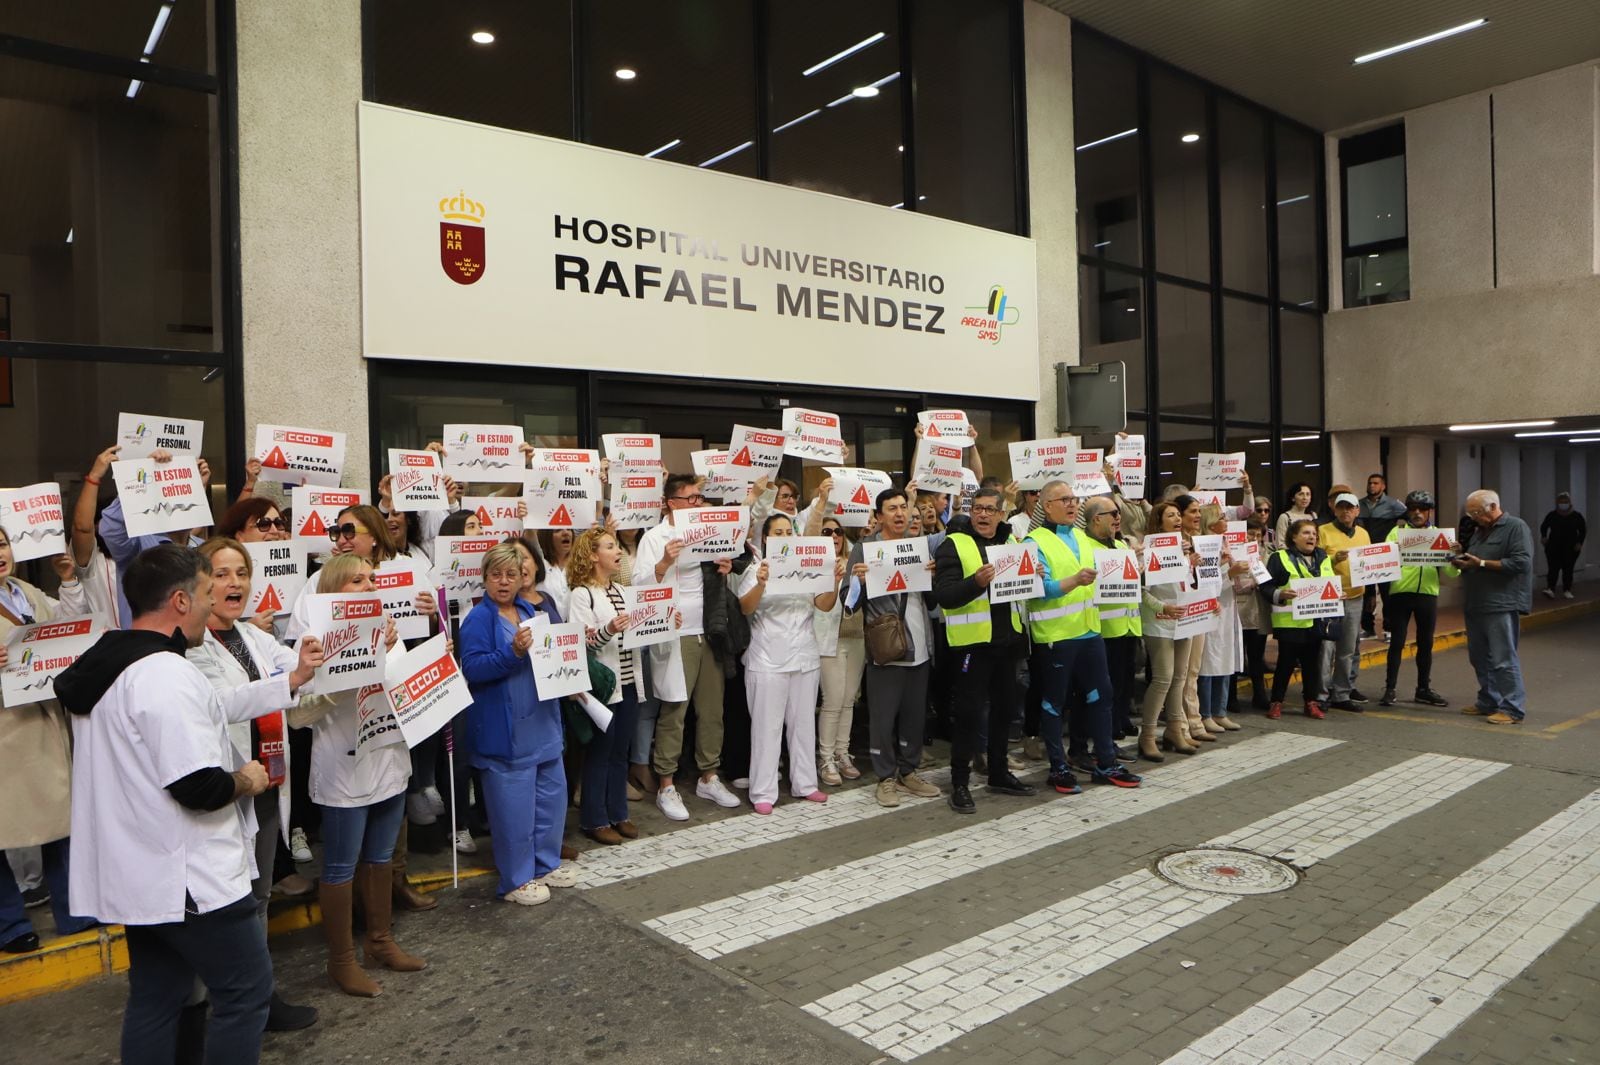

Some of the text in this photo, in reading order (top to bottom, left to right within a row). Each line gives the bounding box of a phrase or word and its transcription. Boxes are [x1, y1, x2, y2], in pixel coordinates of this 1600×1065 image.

[554, 214, 945, 295] HOSPITAL UNIVERSITARIO
[554, 253, 946, 334] RAFAEL MENDEZ
[961, 316, 987, 328] AREA
[977, 330, 999, 341] SMS
[805, 416, 826, 424] CCOO
[163, 424, 185, 435] FALTA
[156, 437, 191, 450] PERSONAL
[288, 434, 319, 444] CCOO
[477, 434, 513, 444] EN ESTADO
[755, 434, 777, 443] CCOO
[808, 436, 825, 444] ESTADO
[483, 446, 509, 456] CRÍTICO
[939, 448, 957, 457] CCOO
[1037, 445, 1067, 456] EN ESTADO
[296, 455, 328, 464] FALTA
[407, 456, 426, 465] CCOO
[1043, 456, 1064, 467] CRÍTICO
[285, 463, 339, 474] PERSONAL
[154, 467, 192, 482] EN ESTADO
[396, 467, 421, 489] URGENTE
[565, 477, 581, 486] FALTA
[162, 483, 192, 497] CRÍTICO
[558, 490, 588, 499] PERSONAL
[324, 495, 350, 504] CCOO
[12, 500, 28, 512] EN
[28, 509, 62, 525] CRÍTICO
[496, 506, 519, 519] FAL
[702, 513, 728, 521] CCOO
[683, 524, 718, 545] URGENTE
[269, 547, 291, 560] FALTA
[795, 545, 827, 555] EN ESTADO
[896, 543, 914, 553] FALTA
[1364, 547, 1382, 555] CCOO
[800, 556, 823, 567] CRÍTICO
[893, 555, 922, 566] PERSONAL
[264, 563, 298, 577] PERSONAL
[458, 569, 465, 577] EN
[466, 568, 481, 577] ESTA
[376, 576, 398, 586] COO
[645, 591, 665, 599] CCOO
[347, 603, 374, 616] CCOO
[382, 601, 411, 609] ALTA
[1189, 601, 1209, 613] CCOO
[630, 603, 657, 627] URGENTE
[644, 619, 664, 627] FALTA
[41, 624, 75, 637] CCOO
[636, 626, 670, 636] PERSONAL
[321, 621, 360, 656] URGENTE
[557, 634, 578, 646] EN ESTADO
[340, 648, 369, 659] FALTA
[33, 661, 44, 672] EN
[45, 656, 73, 670] ESTADO
[328, 660, 377, 675] PERSONAL
[408, 666, 440, 696] CCOO
[262, 741, 284, 753] CCO
